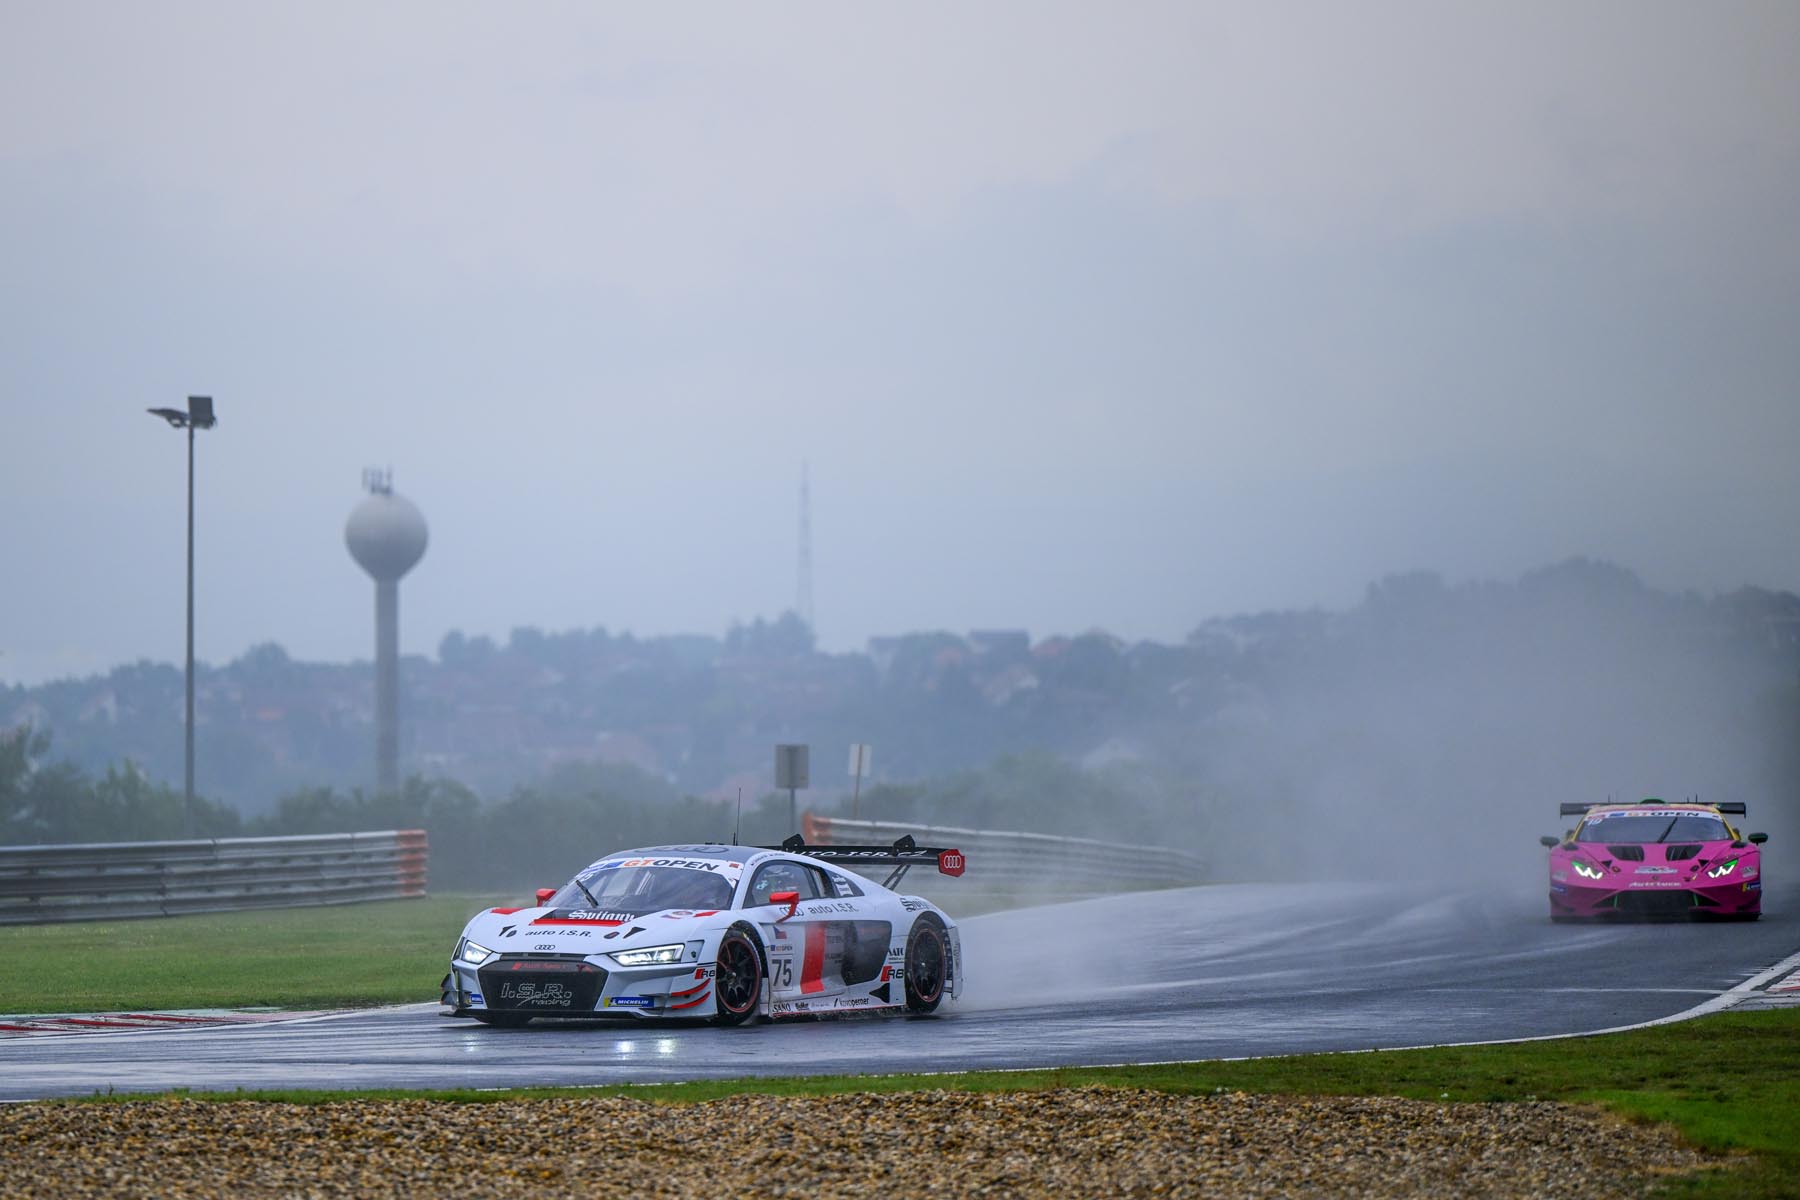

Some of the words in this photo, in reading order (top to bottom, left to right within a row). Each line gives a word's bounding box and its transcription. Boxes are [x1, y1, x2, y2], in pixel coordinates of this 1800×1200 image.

[623, 859, 720, 871] GTOPEN
[807, 905, 832, 914] auto
[771, 958, 793, 987] 75
